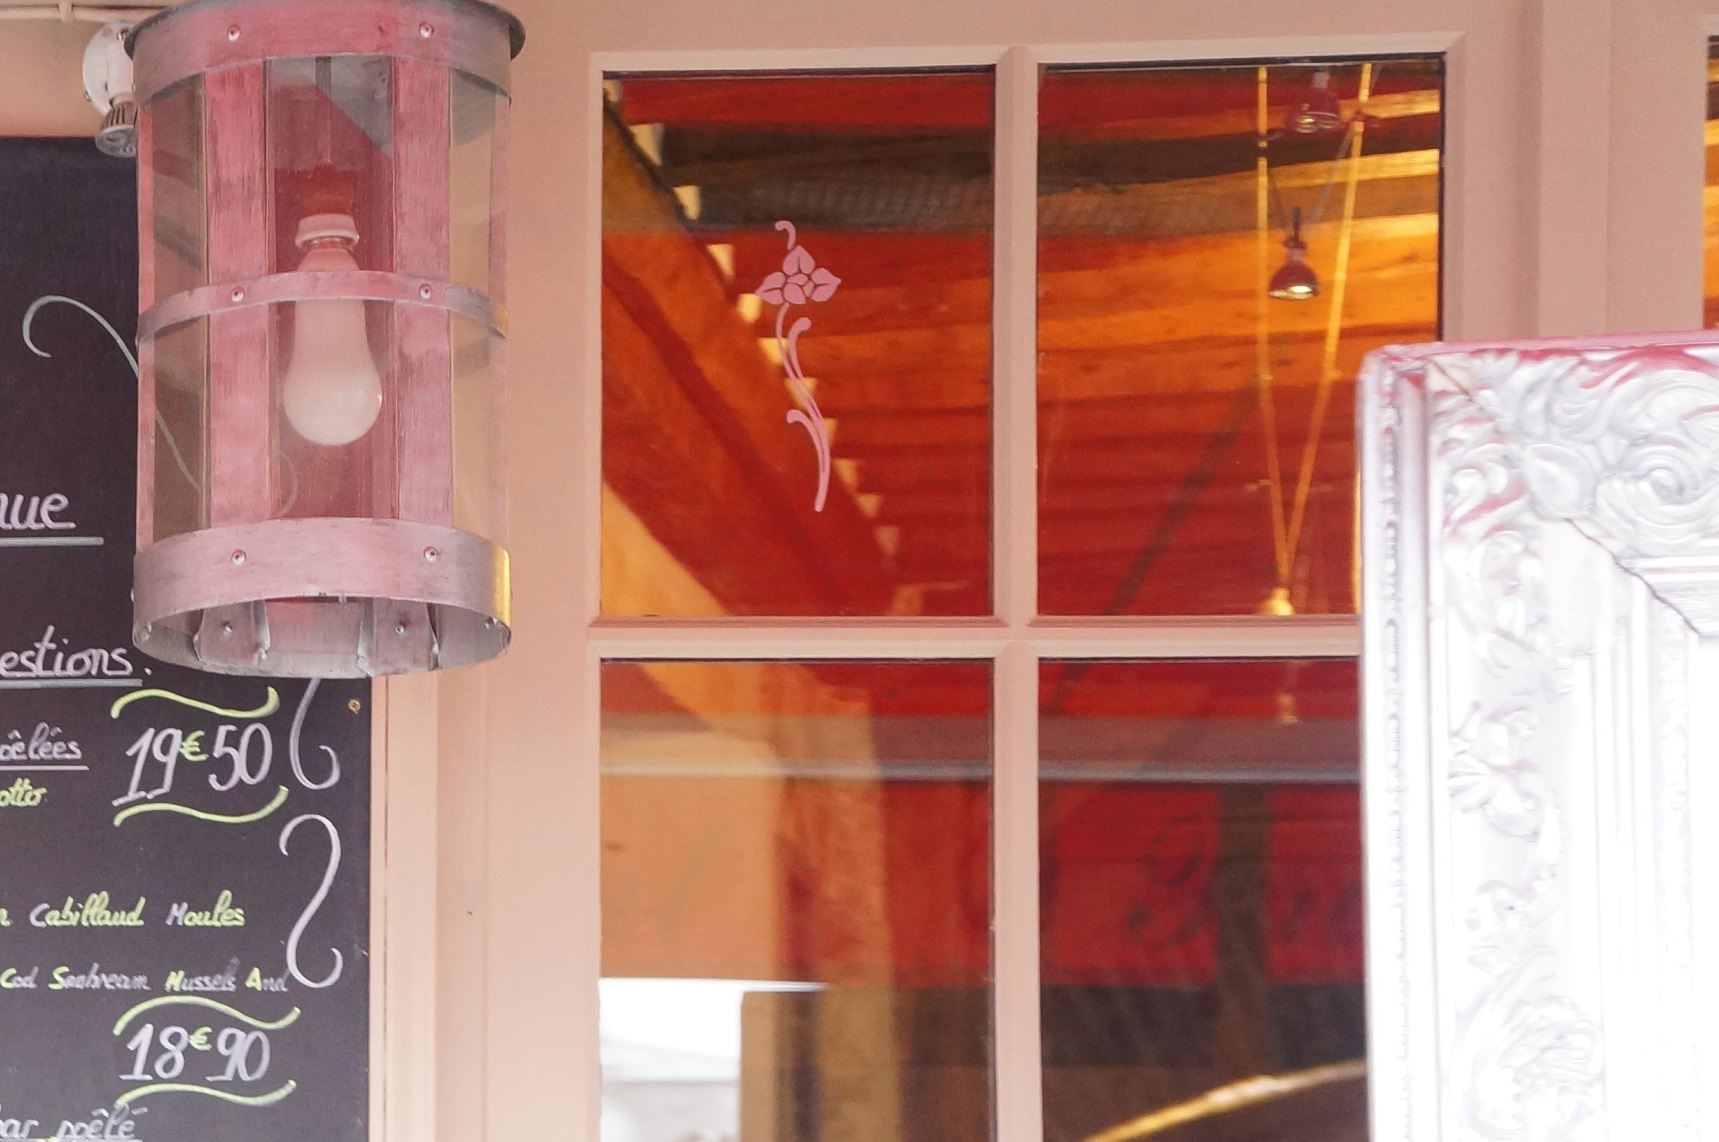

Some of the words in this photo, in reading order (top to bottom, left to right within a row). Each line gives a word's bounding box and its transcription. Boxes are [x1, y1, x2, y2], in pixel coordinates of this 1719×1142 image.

[112, 722, 273, 807] 19€50
[29, 890, 145, 927] Cabillaud
[165, 889, 246, 927] Moules
[0, 966, 39, 989] Cod
[164, 956, 240, 992] Mussels
[119, 1023, 271, 1082] 18€90
